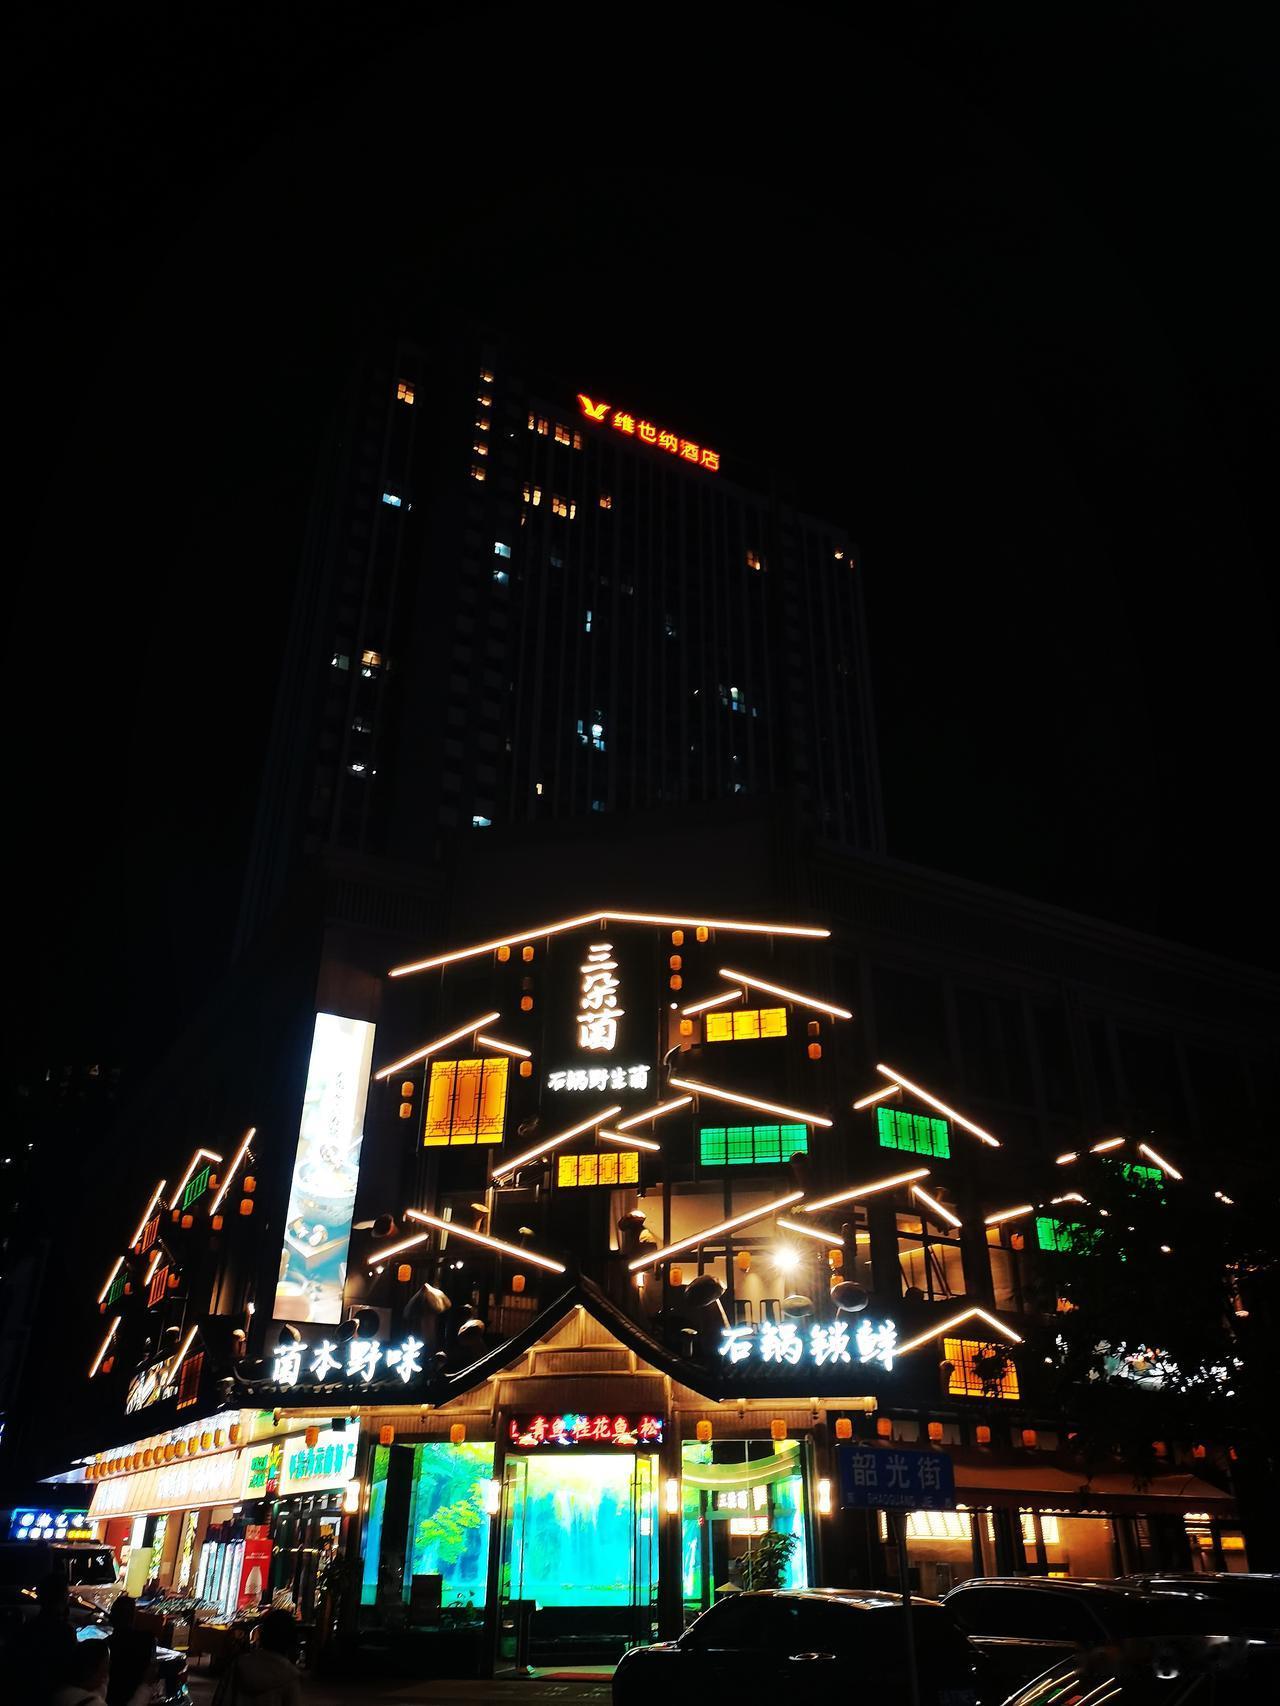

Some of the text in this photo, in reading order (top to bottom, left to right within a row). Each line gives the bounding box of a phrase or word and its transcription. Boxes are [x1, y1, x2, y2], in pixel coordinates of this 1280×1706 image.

[613, 411, 721, 471] 维也纳酒店
[576, 943, 626, 1051] 三朵菌
[272, 1336, 424, 1386] 菌本野味
[852, 1452, 942, 1490] 韶光街
